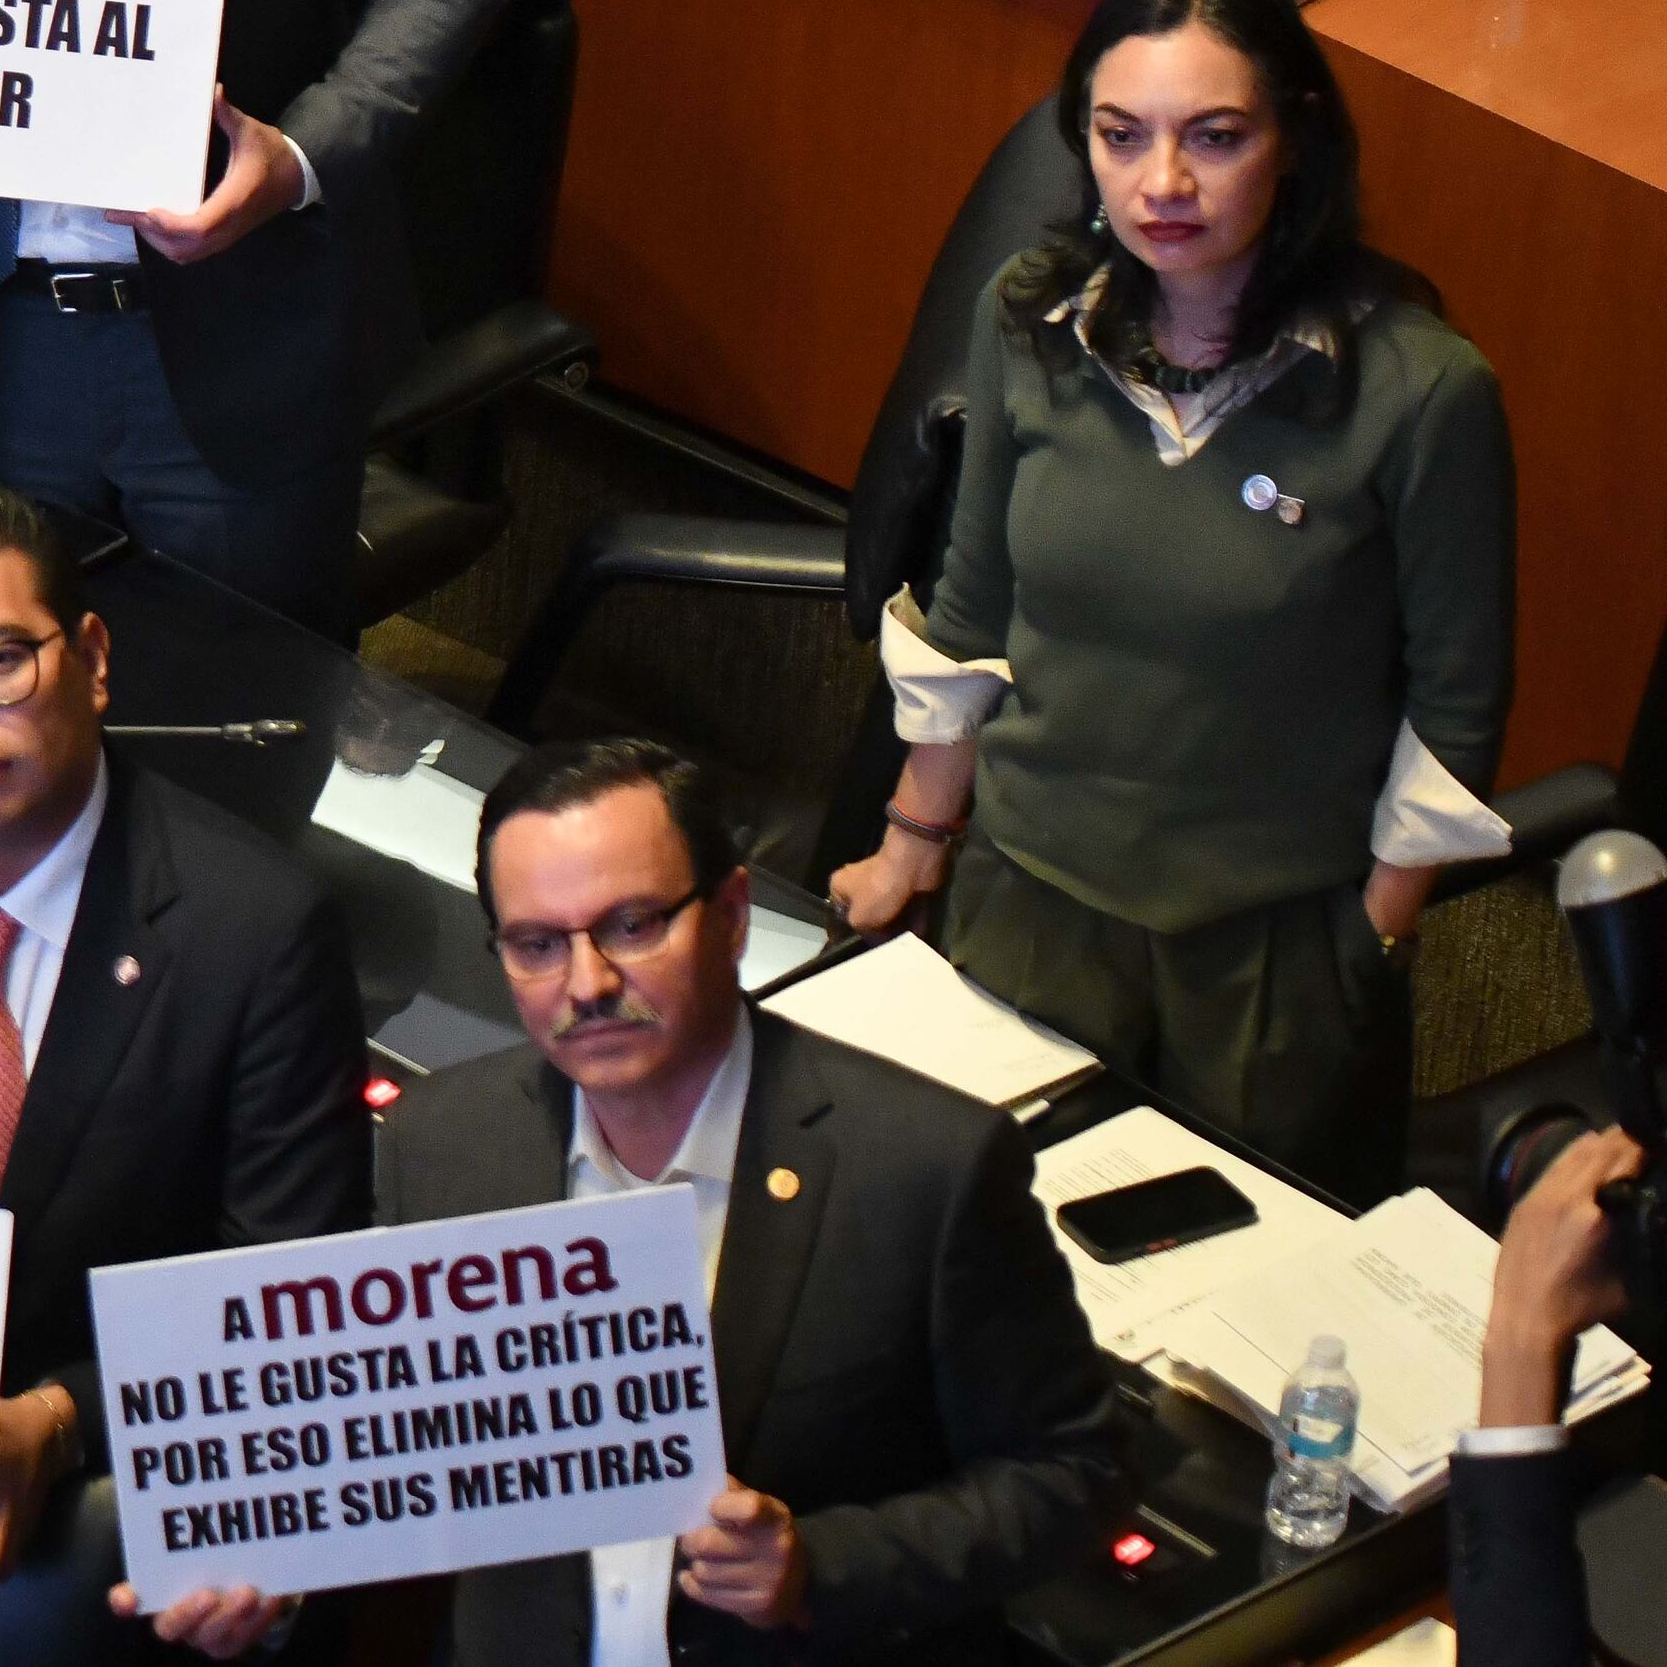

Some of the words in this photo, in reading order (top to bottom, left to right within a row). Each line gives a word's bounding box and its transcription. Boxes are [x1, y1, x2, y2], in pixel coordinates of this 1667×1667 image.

[93, 1, 154, 61] AL
[224, 1298, 254, 1342] A
[261, 1238, 618, 1340] morena
[121, 1377, 186, 1426] NO
[199, 1369, 248, 1416] LE
[260, 1345, 418, 1407] GUSTA
[428, 1335, 485, 1384] LA
[496, 1303, 704, 1373] CRÍTICA,
[132, 1438, 229, 1491] POR
[241, 1423, 331, 1476] ESO
[344, 1394, 539, 1462] ELIMINA
[549, 1383, 602, 1431] LO
[616, 1366, 709, 1424] QUE
[163, 1488, 330, 1552] EXHIBE
[341, 1473, 437, 1527] SUS
[449, 1435, 693, 1512] MENTIRAS
